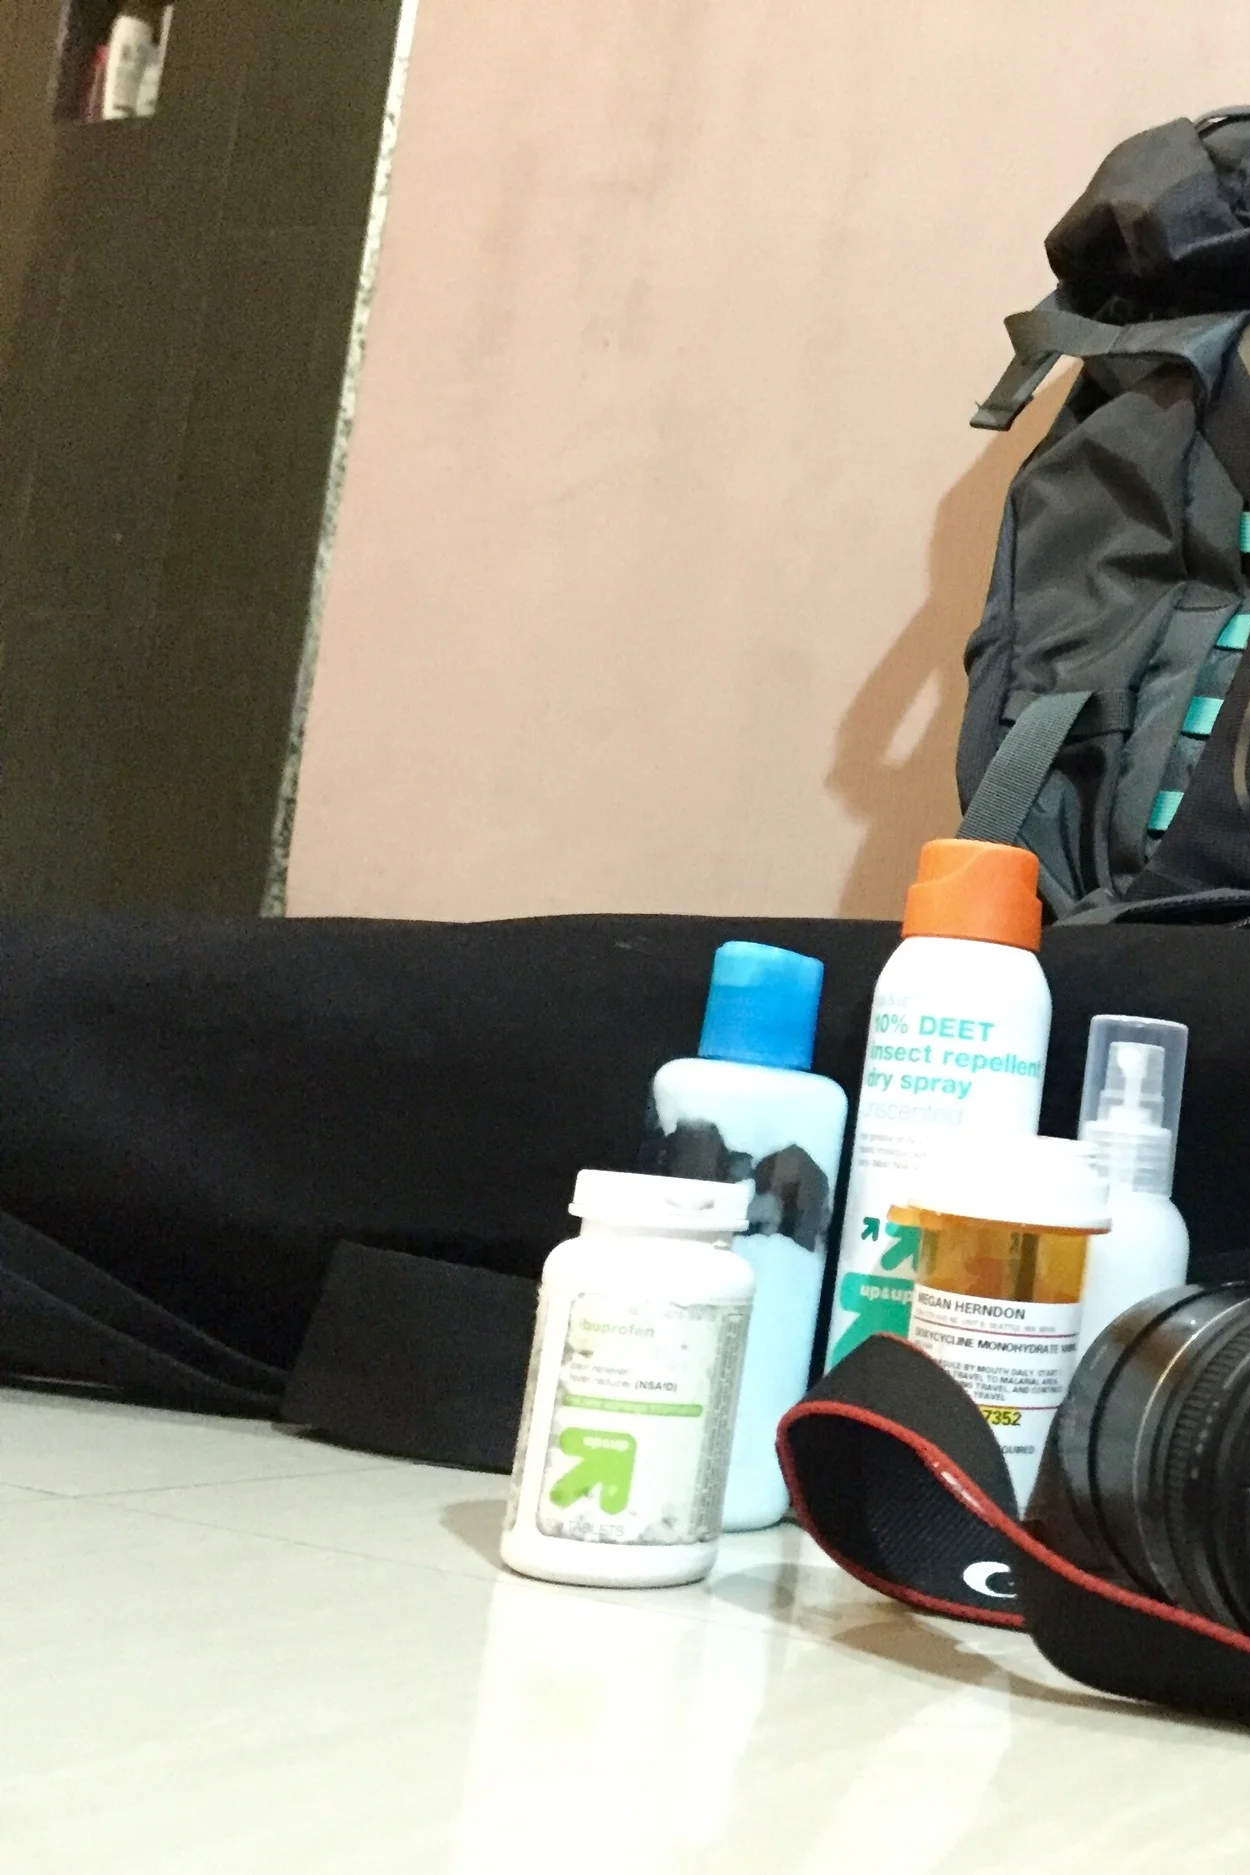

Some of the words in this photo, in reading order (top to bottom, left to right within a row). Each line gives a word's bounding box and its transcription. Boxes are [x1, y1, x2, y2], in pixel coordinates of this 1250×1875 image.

[873, 1013, 909, 1035] 10%
[919, 1015, 996, 1042] DEET
[868, 1040, 933, 1064] insect
[942, 1049, 1041, 1080] repellent
[866, 1068, 894, 1092] dry
[900, 1074, 973, 1099] spray
[918, 1291, 952, 1310] MEGAN
[955, 1299, 1027, 1320] HERNDON
[578, 1316, 656, 1338] ibuprofen
[977, 1339, 1059, 1354] MONOHYDRATE
